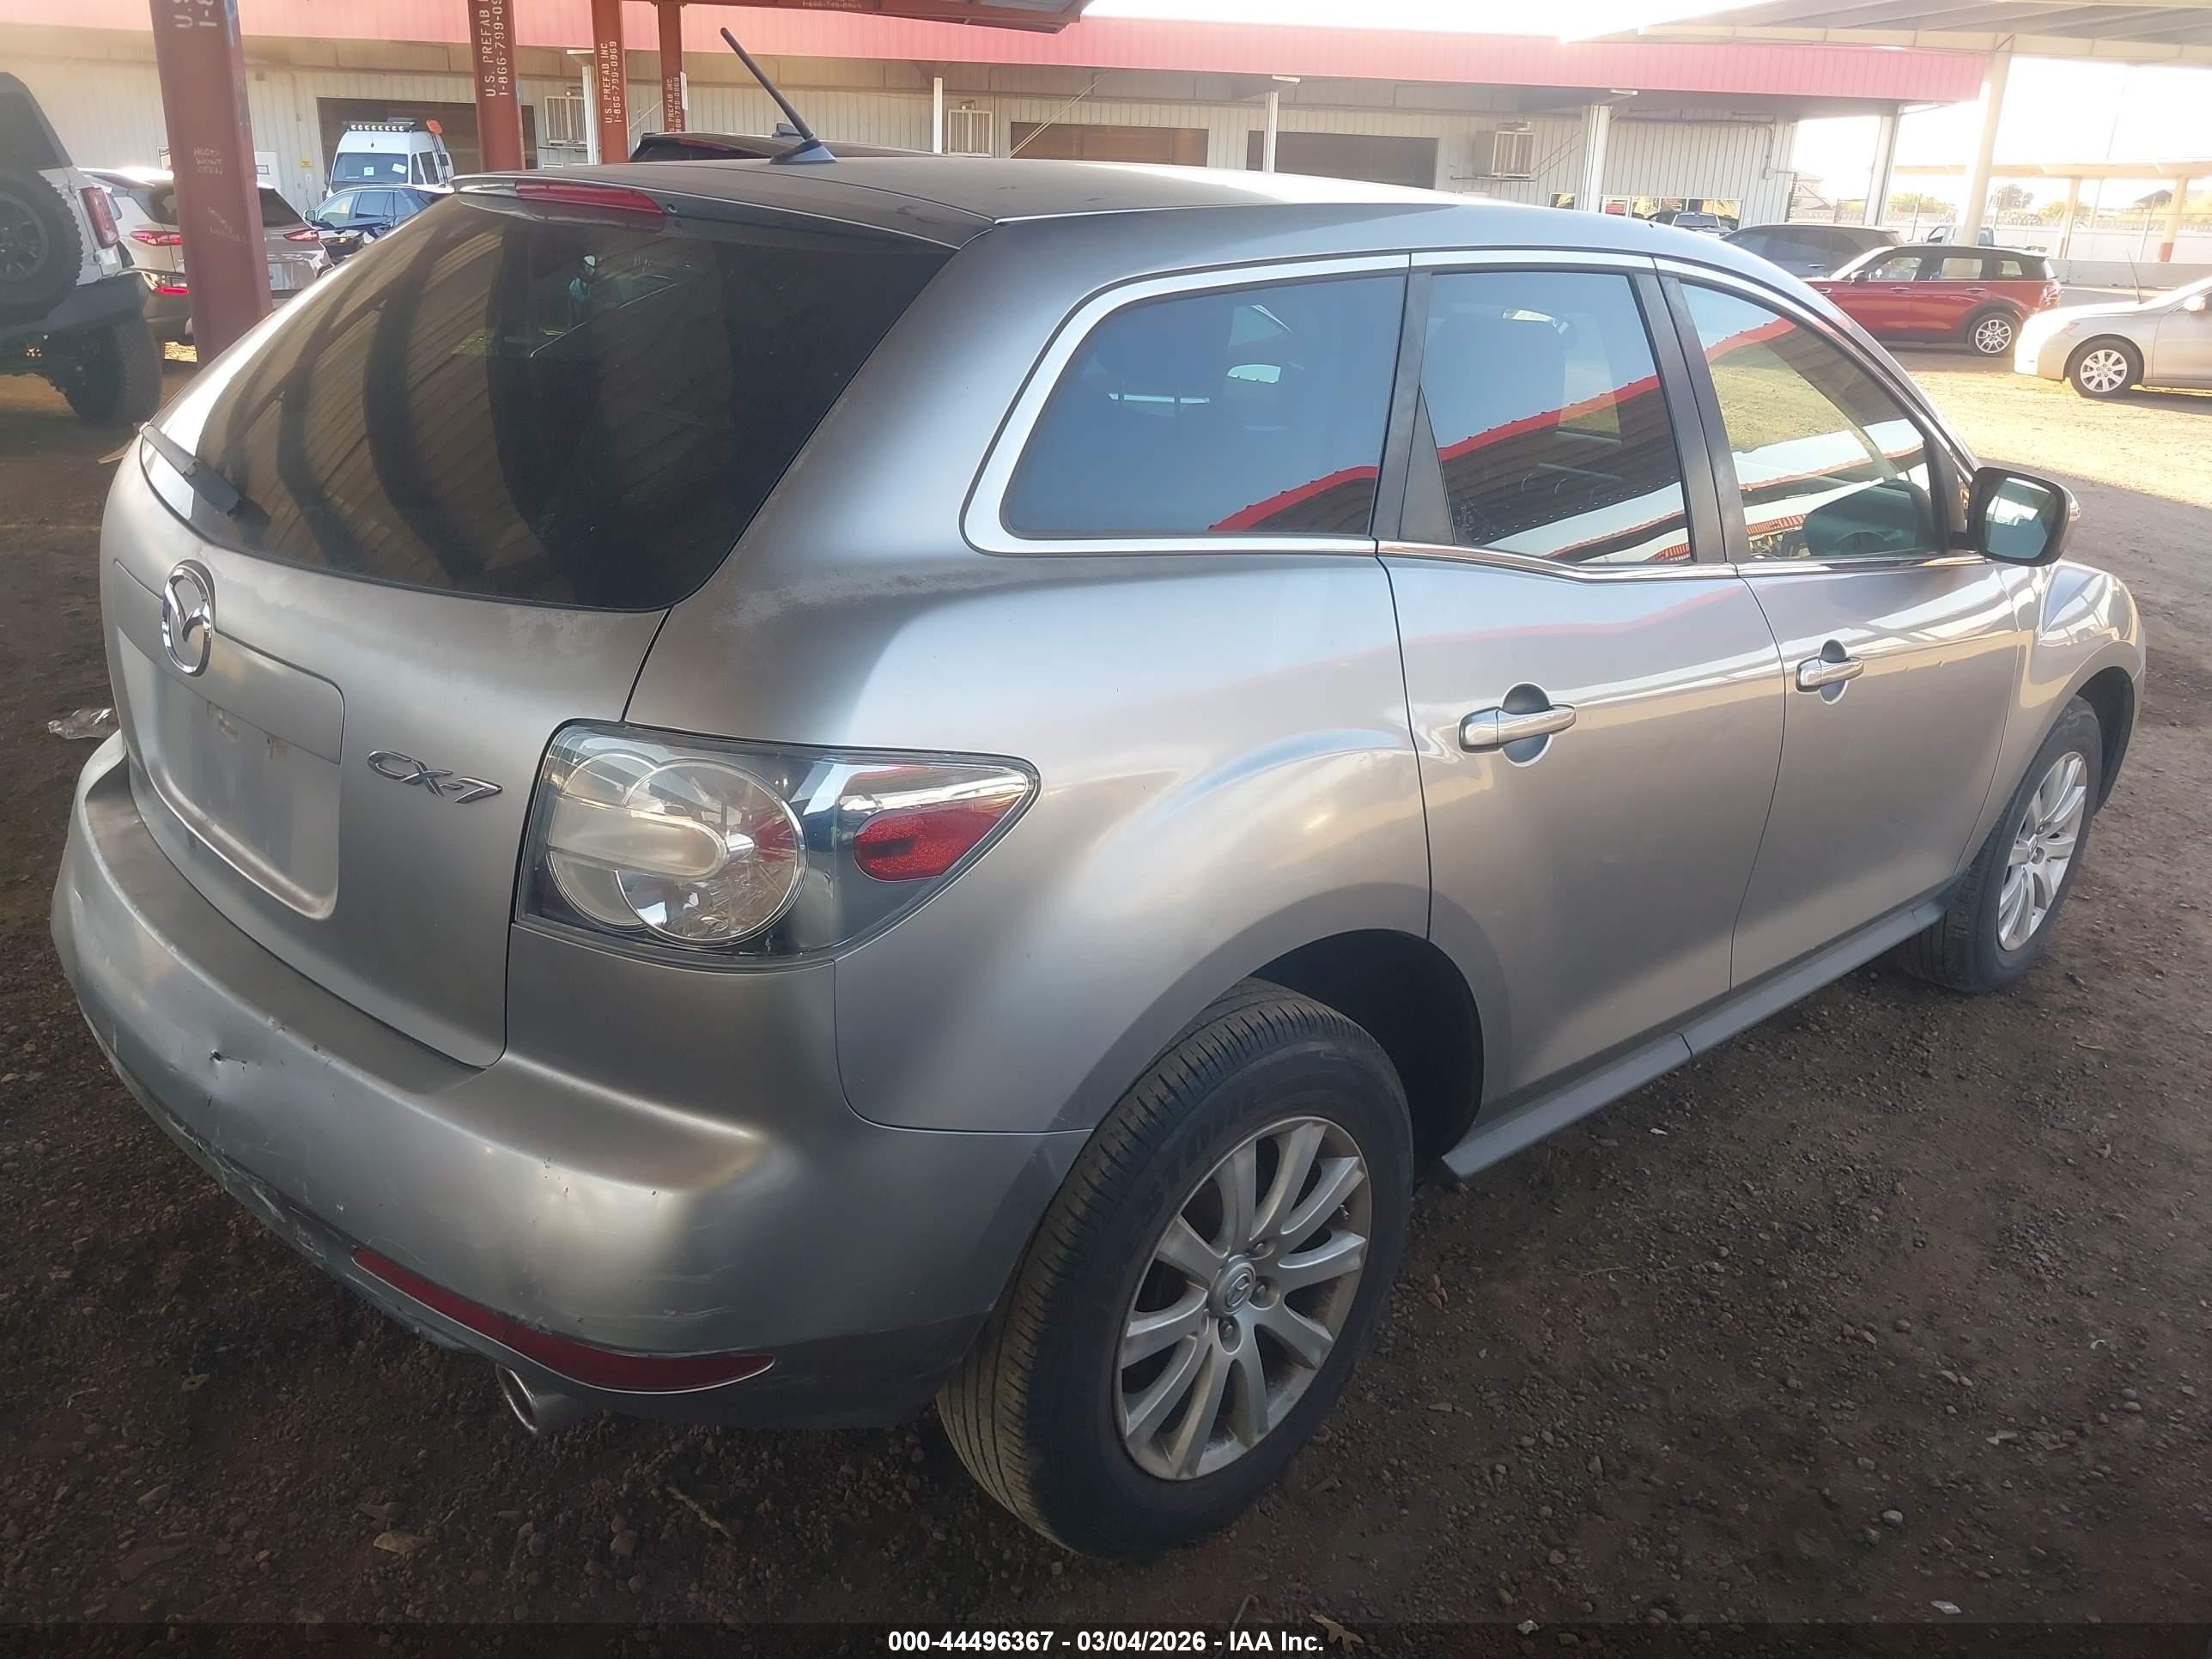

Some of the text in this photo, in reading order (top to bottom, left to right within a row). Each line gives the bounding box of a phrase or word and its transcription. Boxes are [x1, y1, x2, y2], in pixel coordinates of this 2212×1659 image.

[479, 9, 496, 97] U.S. PREFAB
[601, 63, 612, 100] PREFAB
[609, 40, 623, 123] 1-866-799-0969
[605, 105, 613, 124] U.S.
[368, 750, 503, 804] CX-7
